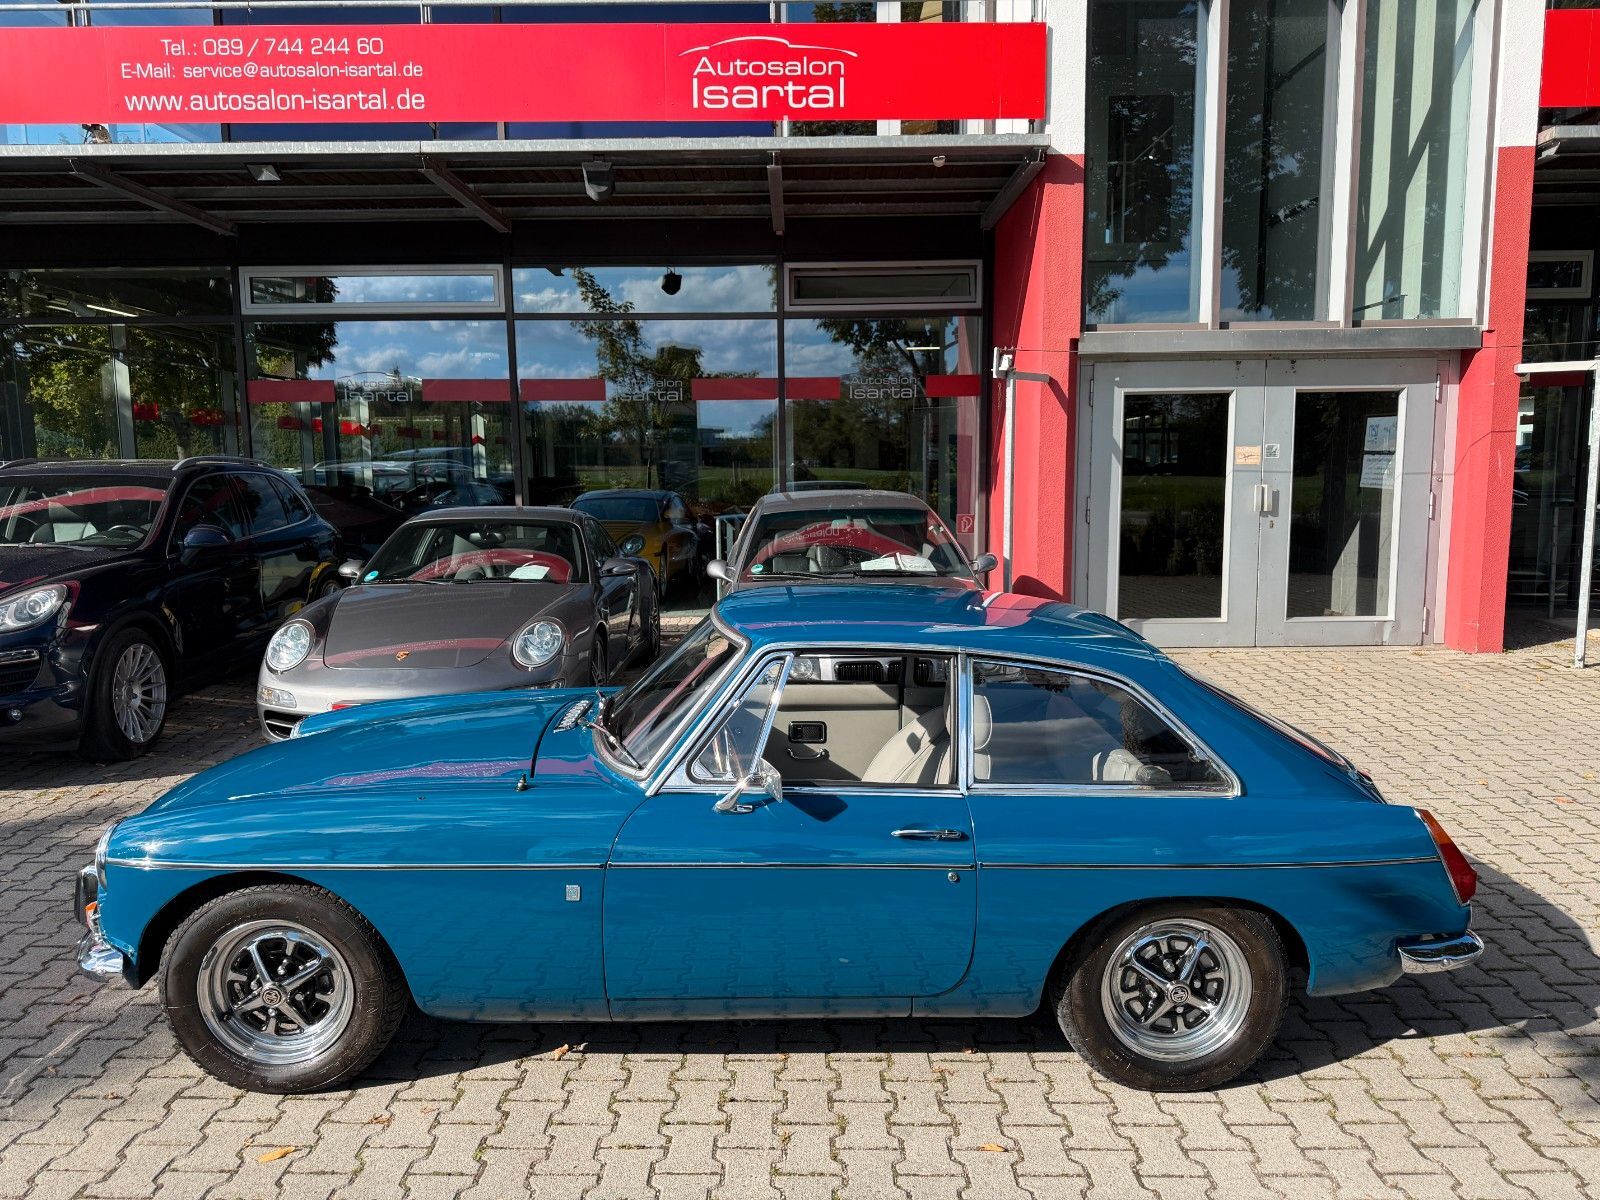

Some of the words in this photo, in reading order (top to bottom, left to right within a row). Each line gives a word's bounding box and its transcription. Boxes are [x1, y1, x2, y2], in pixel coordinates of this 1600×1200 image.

[160, 39, 198, 56] Tel.:
[203, 38, 244, 56] 089
[263, 38, 304, 55] 744
[310, 37, 351, 55] 244
[356, 37, 384, 55] 60
[120, 62, 176, 79] E-Mail:
[183, 61, 424, 79] service@autosalon-isartal.de
[692, 56, 845, 76] Autosalon
[124, 87, 426, 111] www.autosalon-isartal.de
[692, 77, 845, 108] Isartal
[849, 384, 917, 399] Isartal
